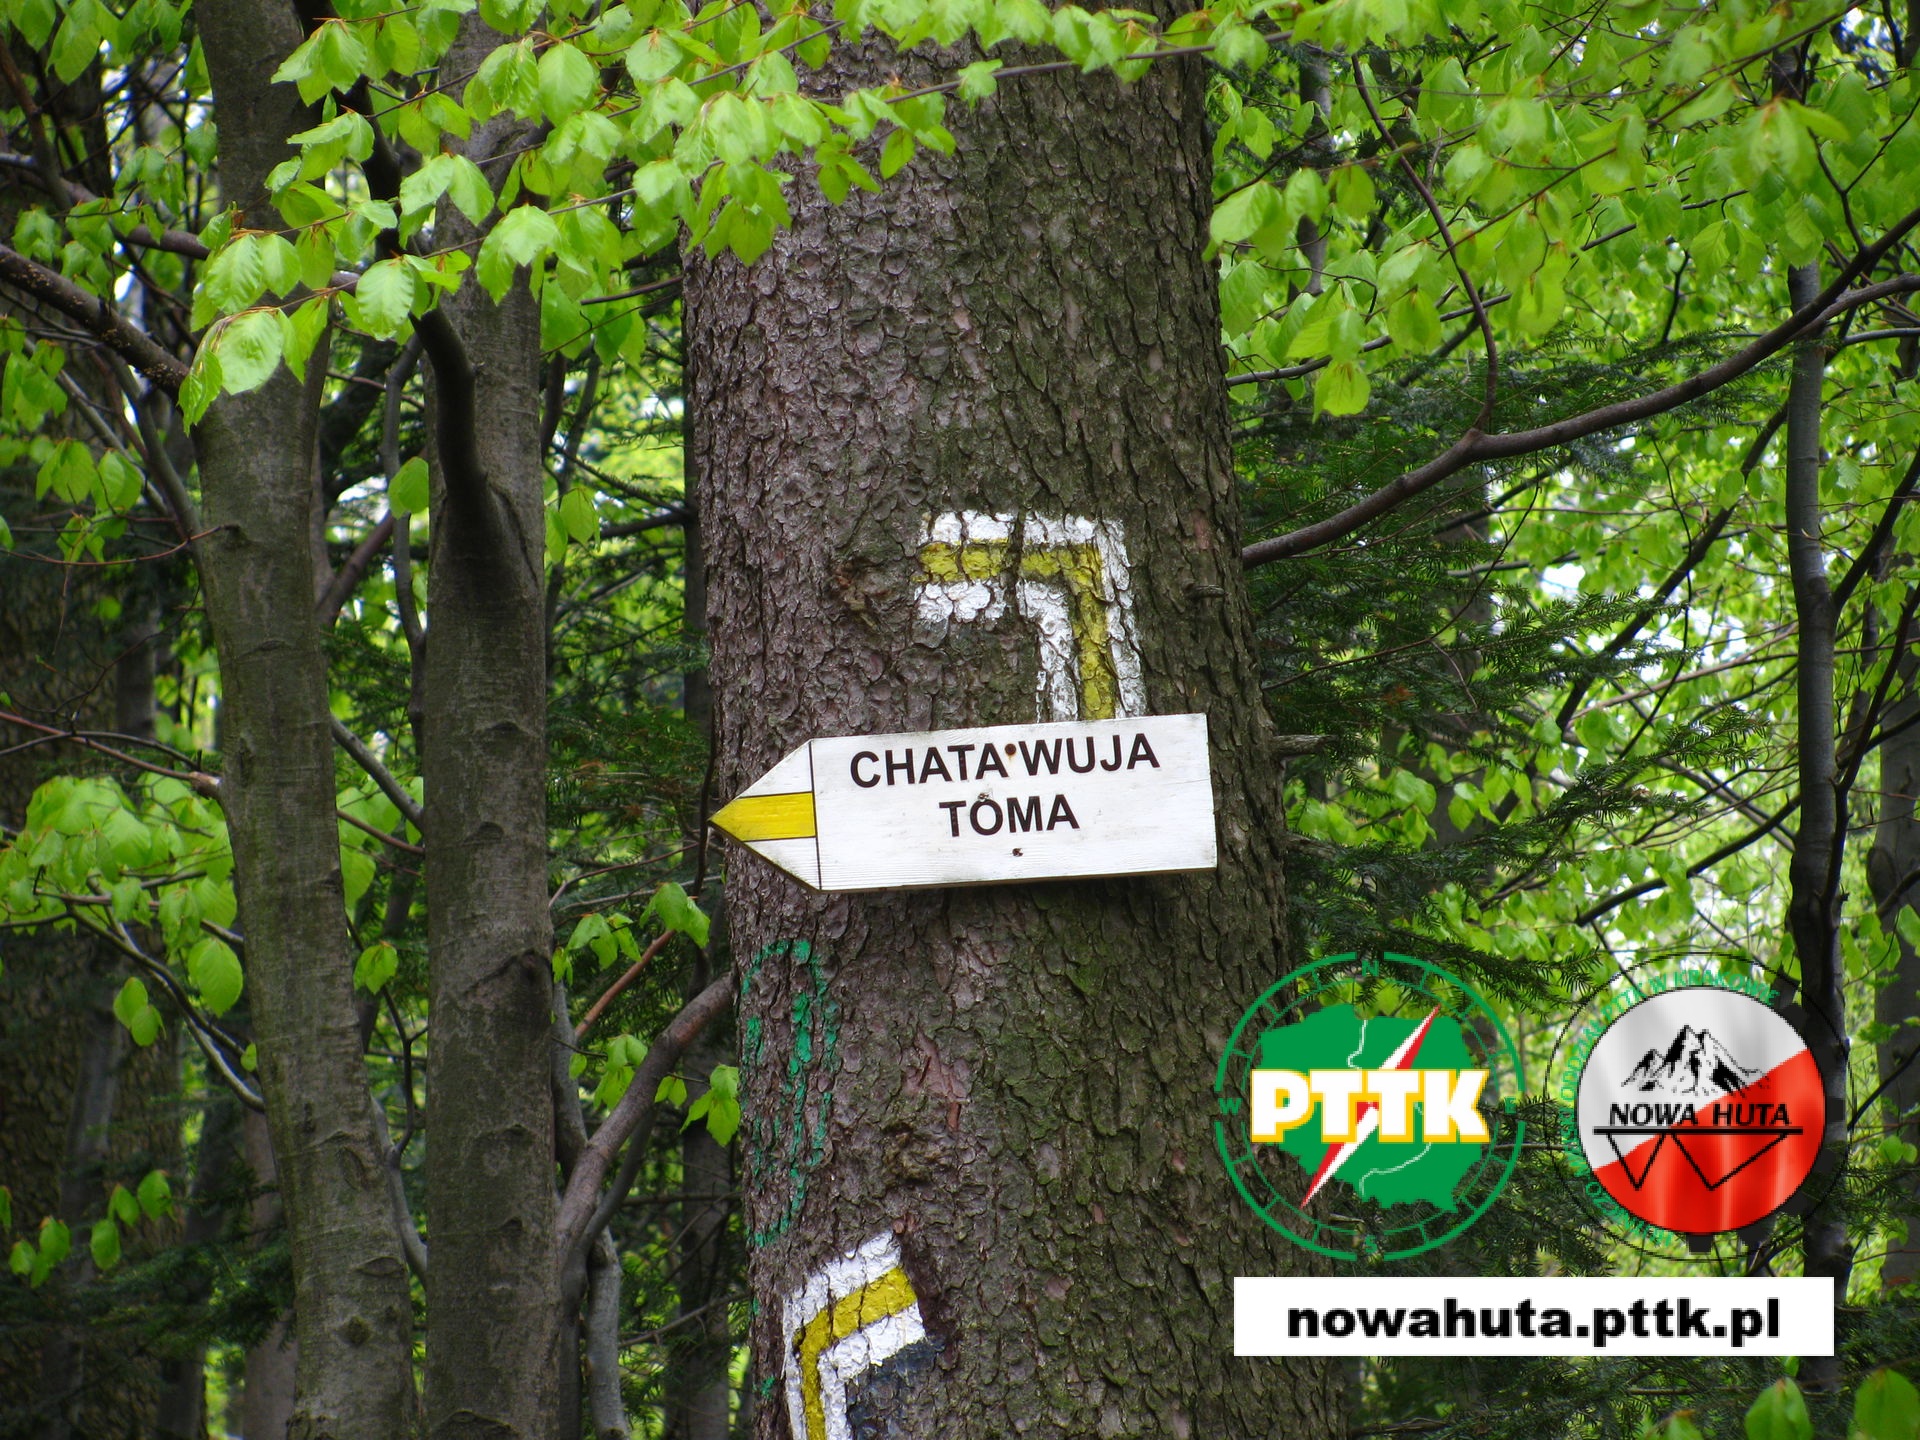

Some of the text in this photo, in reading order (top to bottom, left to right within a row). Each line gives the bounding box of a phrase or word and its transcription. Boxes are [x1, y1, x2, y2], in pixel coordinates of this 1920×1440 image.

[850, 733, 1160, 788] CHATA WUJA
[939, 794, 1080, 837] TOMA
